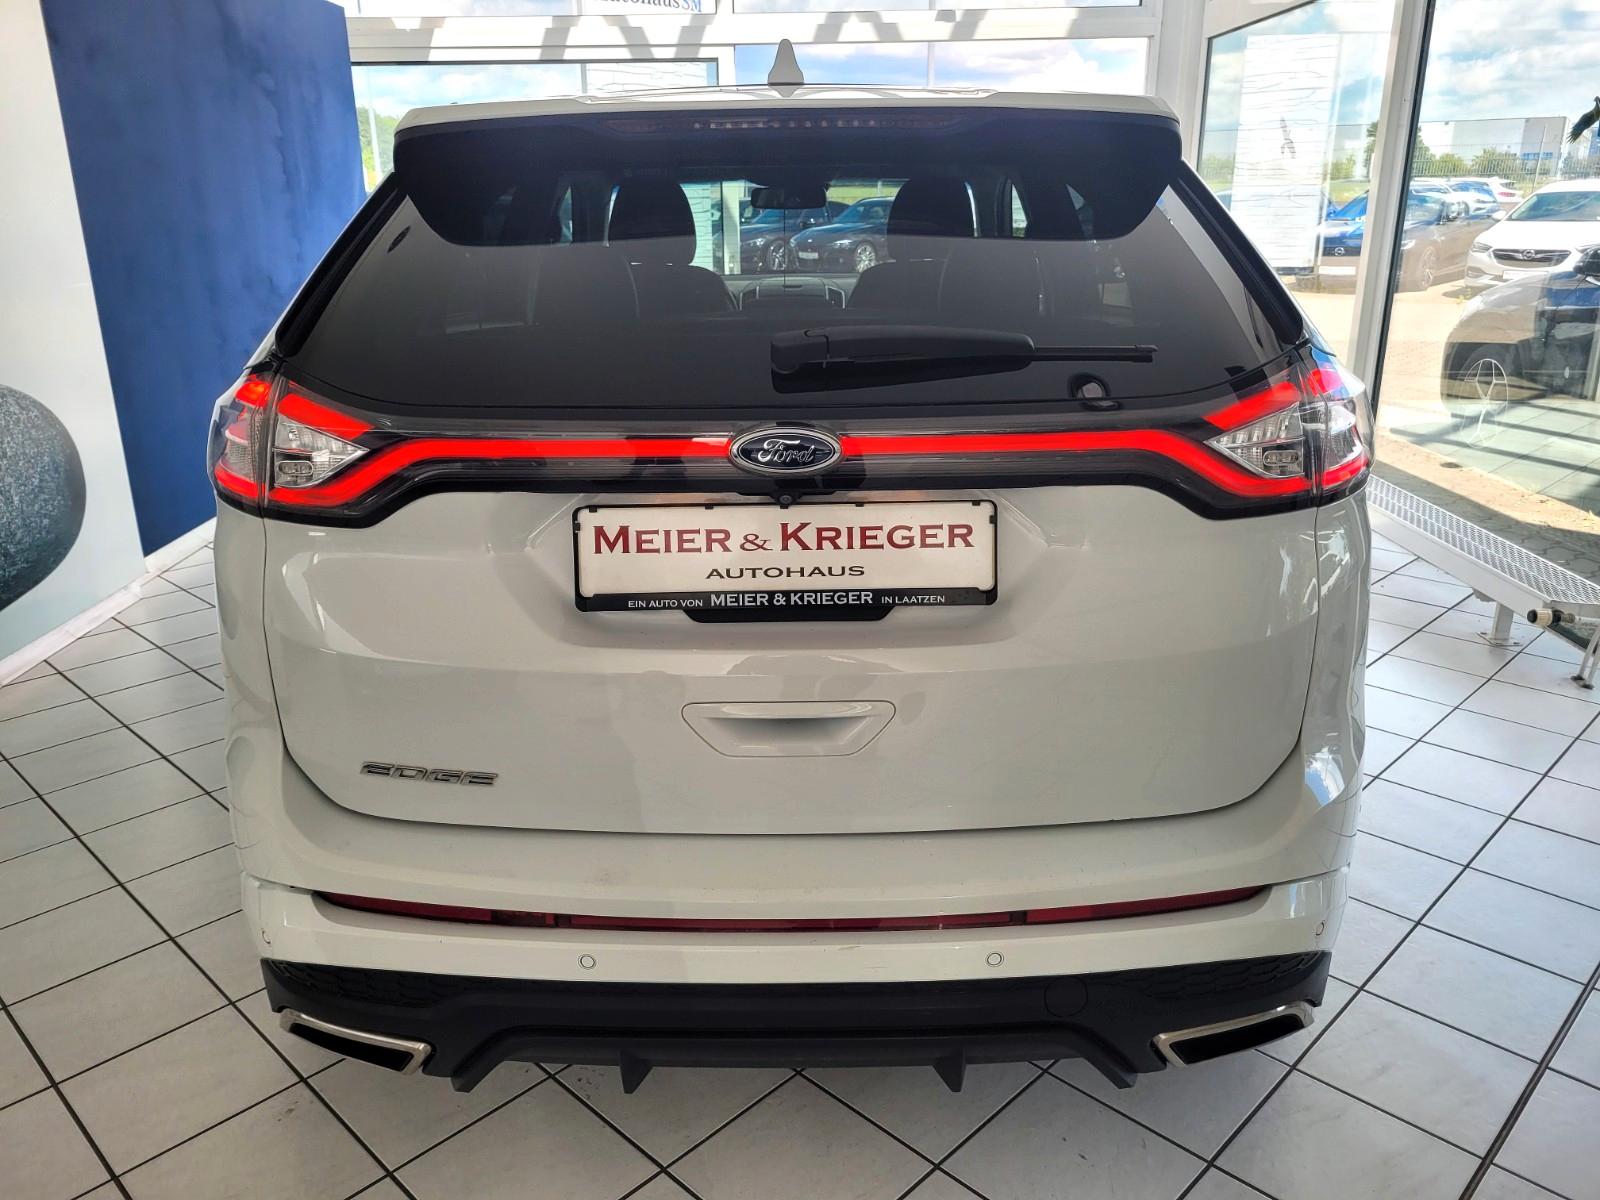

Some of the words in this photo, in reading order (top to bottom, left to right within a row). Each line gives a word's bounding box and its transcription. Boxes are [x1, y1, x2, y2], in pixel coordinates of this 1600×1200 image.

[757, 438, 815, 463] Ford
[592, 524, 733, 555] MEIER
[739, 532, 774, 552] &
[779, 522, 975, 552] KRIEGER
[705, 565, 865, 580] AUTOHAUS
[628, 600, 646, 608] EIN
[649, 599, 678, 608] AUTO
[681, 599, 703, 608] VON
[710, 593, 769, 607] MEIER
[773, 592, 786, 606] &
[790, 591, 873, 606] KRIEGER
[881, 595, 893, 604] IN
[895, 595, 945, 604] LAATZEN
[360, 761, 498, 786] EDGE
